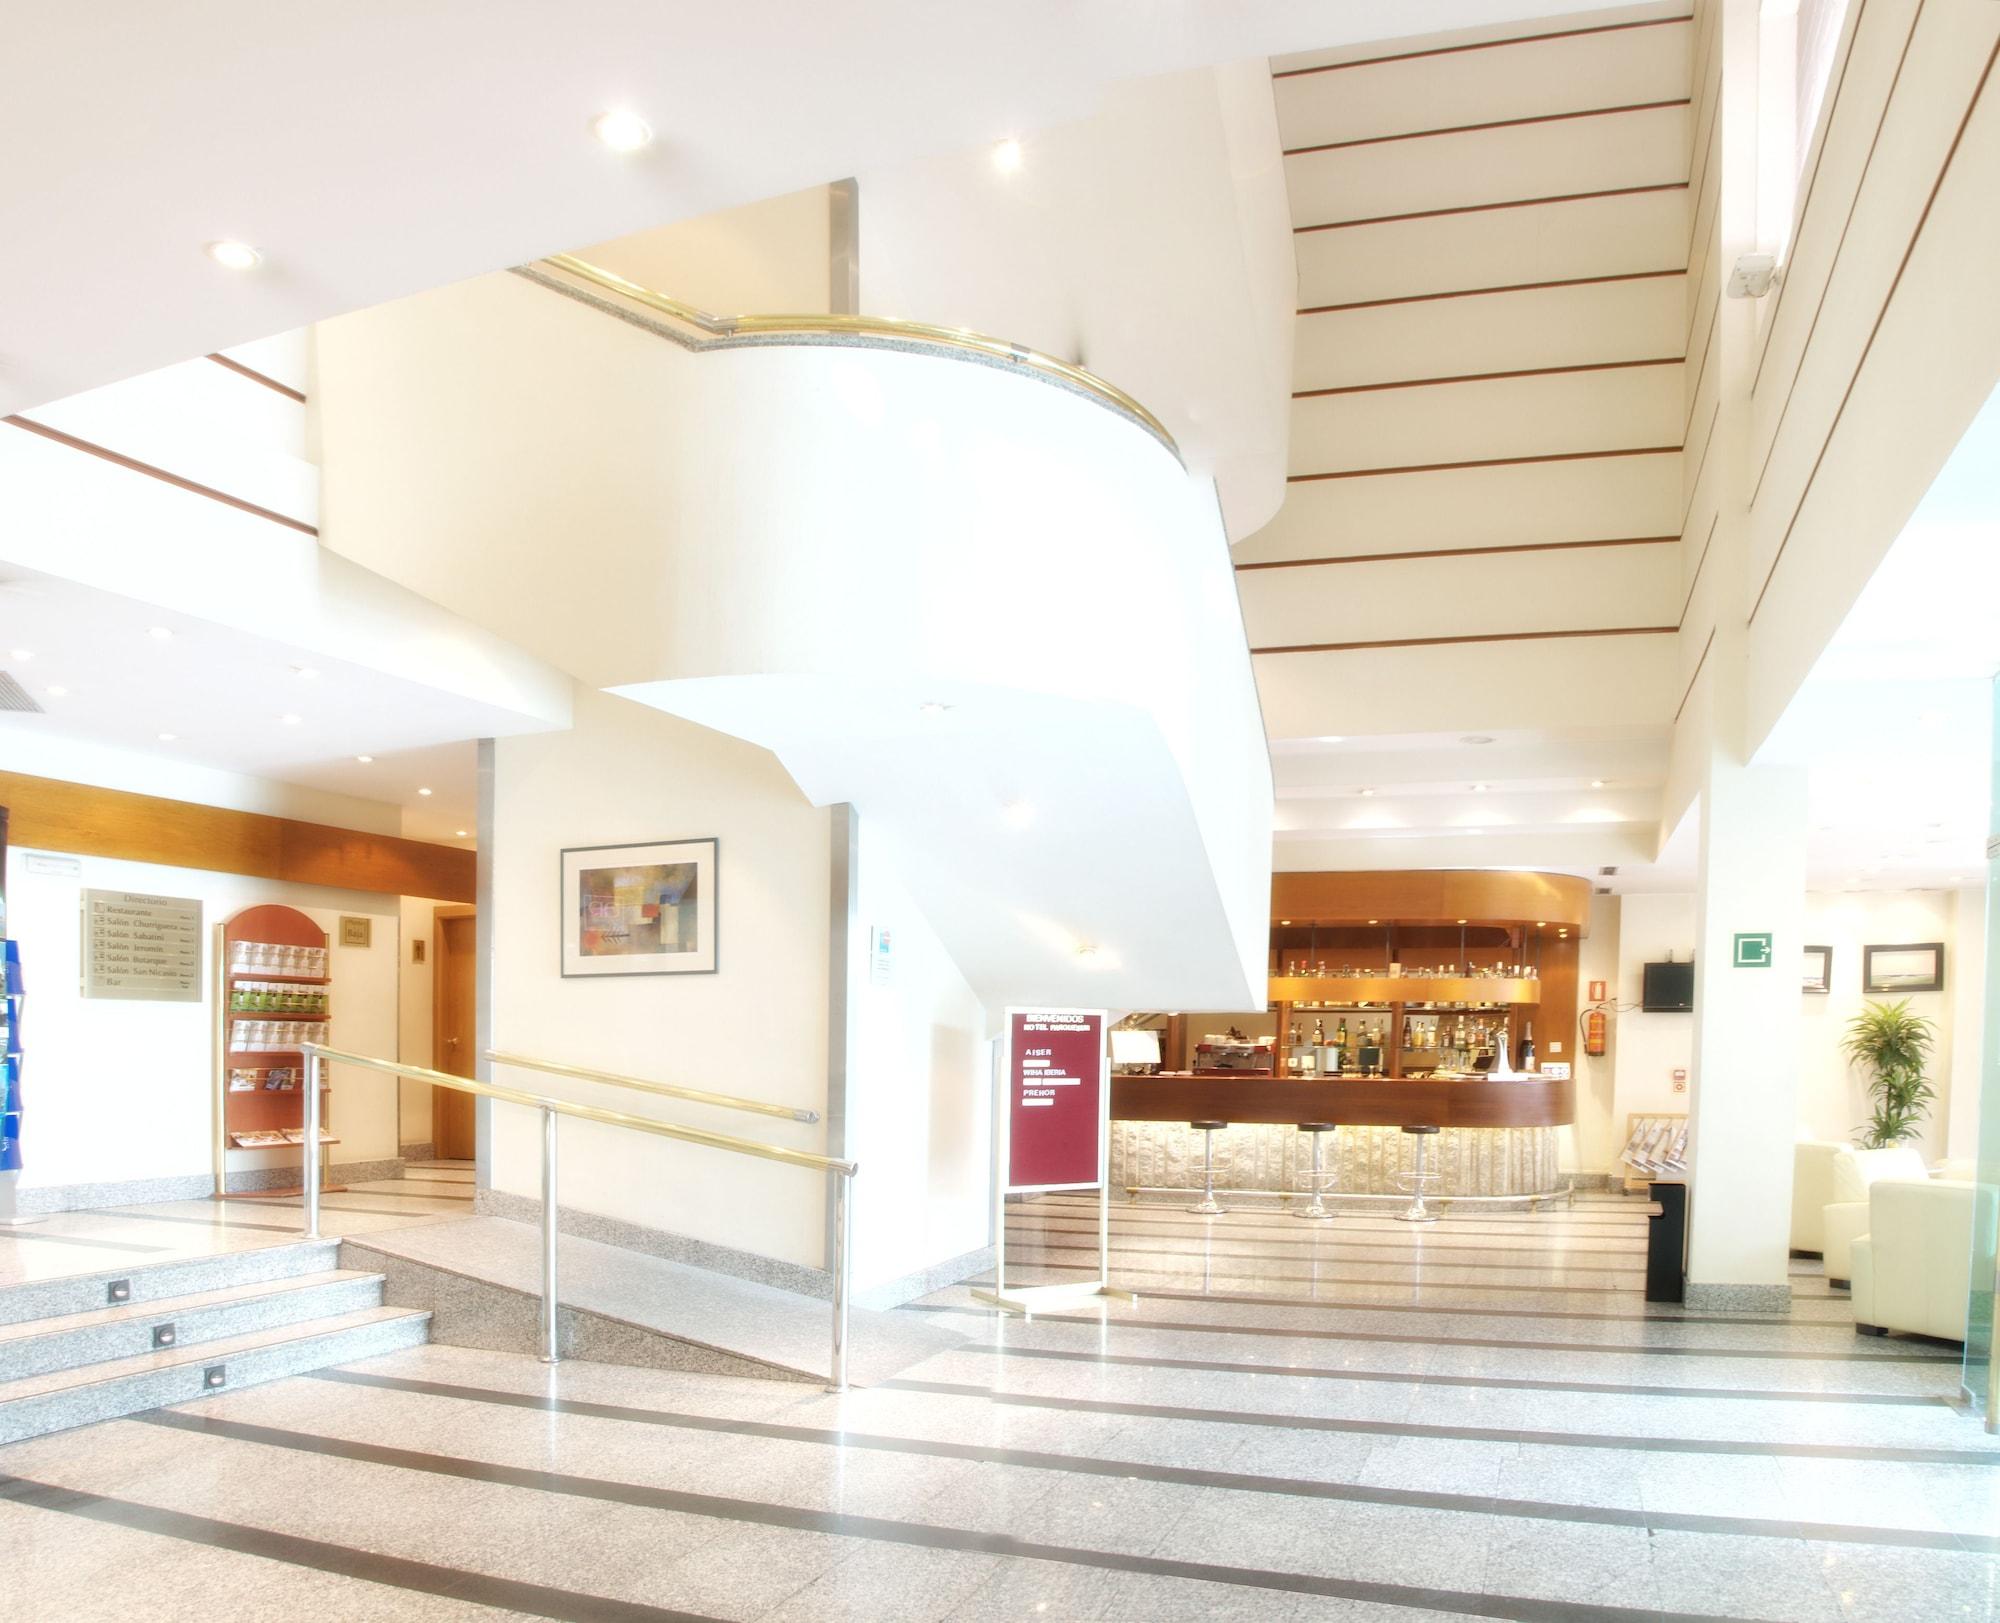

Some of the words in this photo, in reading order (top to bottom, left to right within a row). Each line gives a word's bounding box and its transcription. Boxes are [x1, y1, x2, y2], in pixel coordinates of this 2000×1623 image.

[124, 894, 168, 906] Directorio
[106, 906, 151, 917] Restaurante
[107, 917, 129, 927] Salón
[107, 929, 129, 938] Salón
[133, 931, 165, 942] Sabatini
[107, 941, 129, 951] Salón
[107, 953, 129, 963] Salón
[107, 965, 129, 975] Salón
[107, 977, 121, 985] Bar
[1026, 1014, 1084, 1023] BIENVENIDOS
